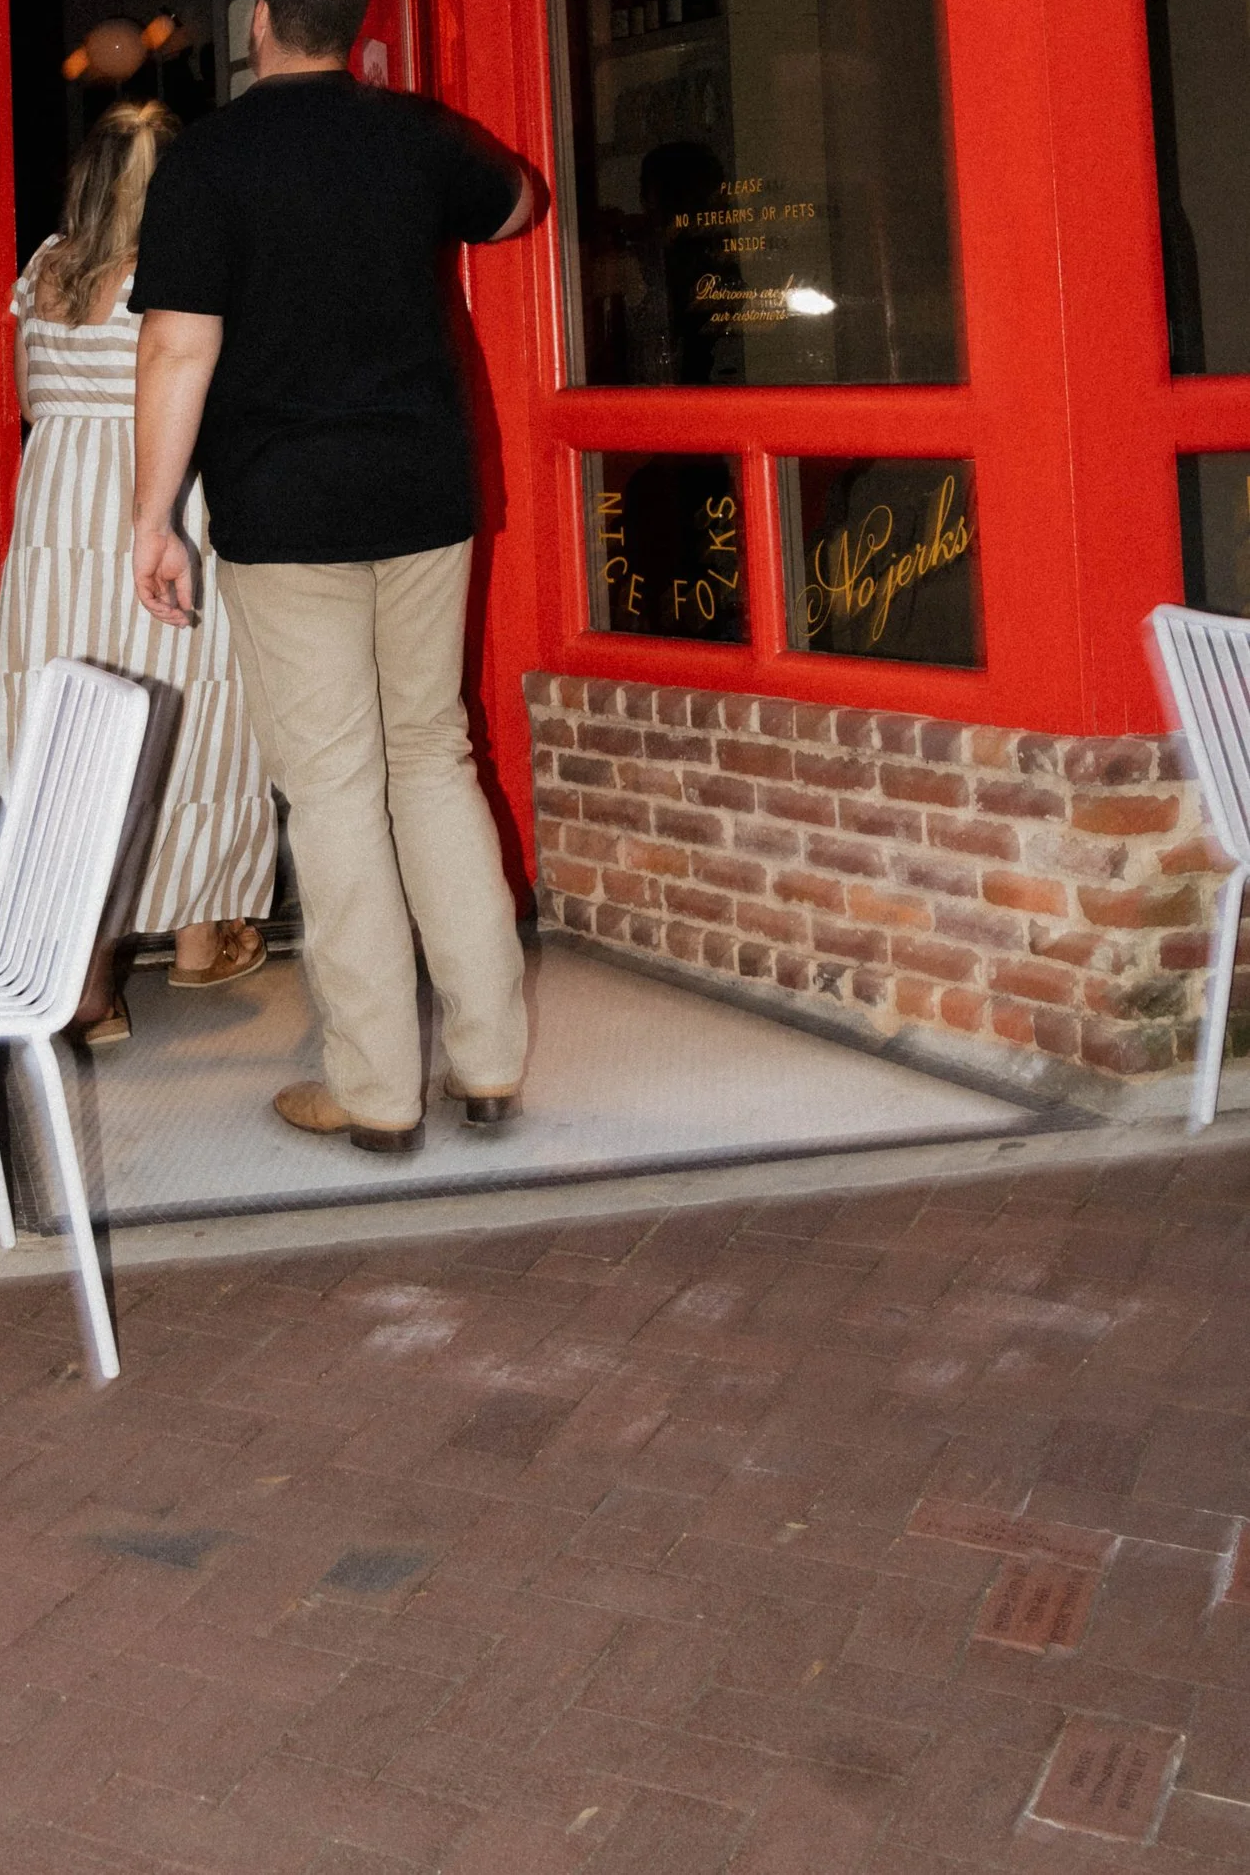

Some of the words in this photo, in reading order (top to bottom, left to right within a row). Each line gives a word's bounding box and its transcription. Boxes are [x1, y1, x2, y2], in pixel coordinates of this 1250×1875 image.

[720, 178, 764, 195] PLEASE
[675, 213, 690, 228] NO
[696, 207, 755, 226] FIREARMS
[761, 206, 776, 221] OR
[784, 203, 815, 219] PETS
[722, 236, 766, 252] INSIDE
[696, 273, 758, 300] Restrooms
[711, 311, 730, 322] our
[597, 492, 645, 616] NICE
[673, 496, 739, 621] FOLKS
